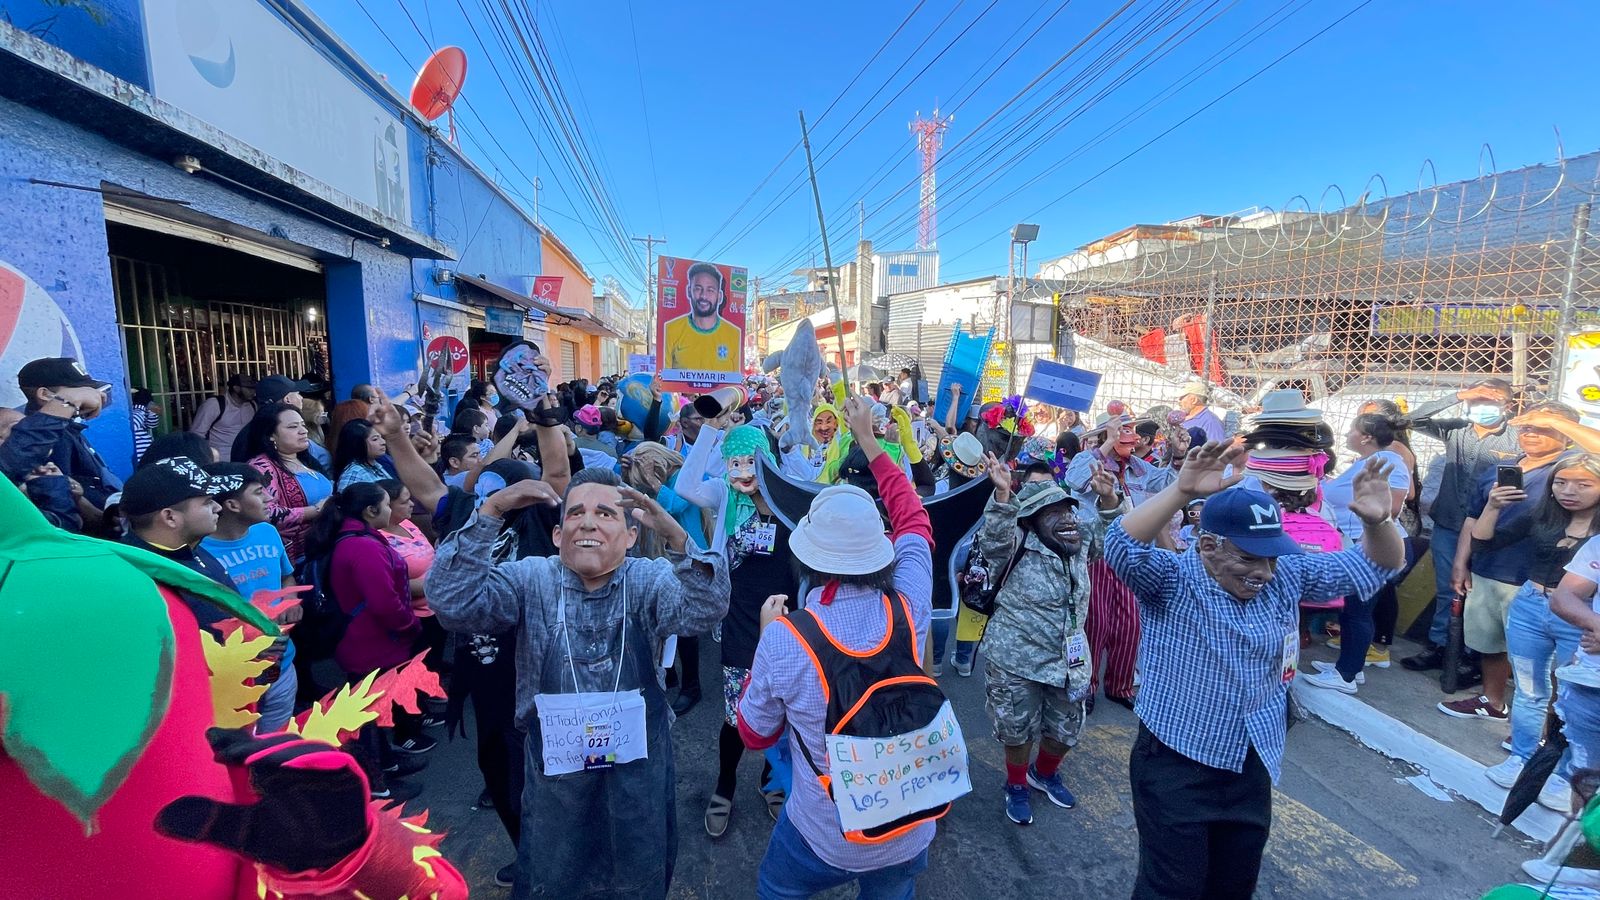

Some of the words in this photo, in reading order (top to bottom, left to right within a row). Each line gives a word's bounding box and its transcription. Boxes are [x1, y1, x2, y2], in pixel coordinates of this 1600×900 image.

[680, 371, 716, 380] NEYMAR
[1250, 504, 1279, 524] M
[759, 533, 772, 541] 056
[588, 736, 610, 748] 027
